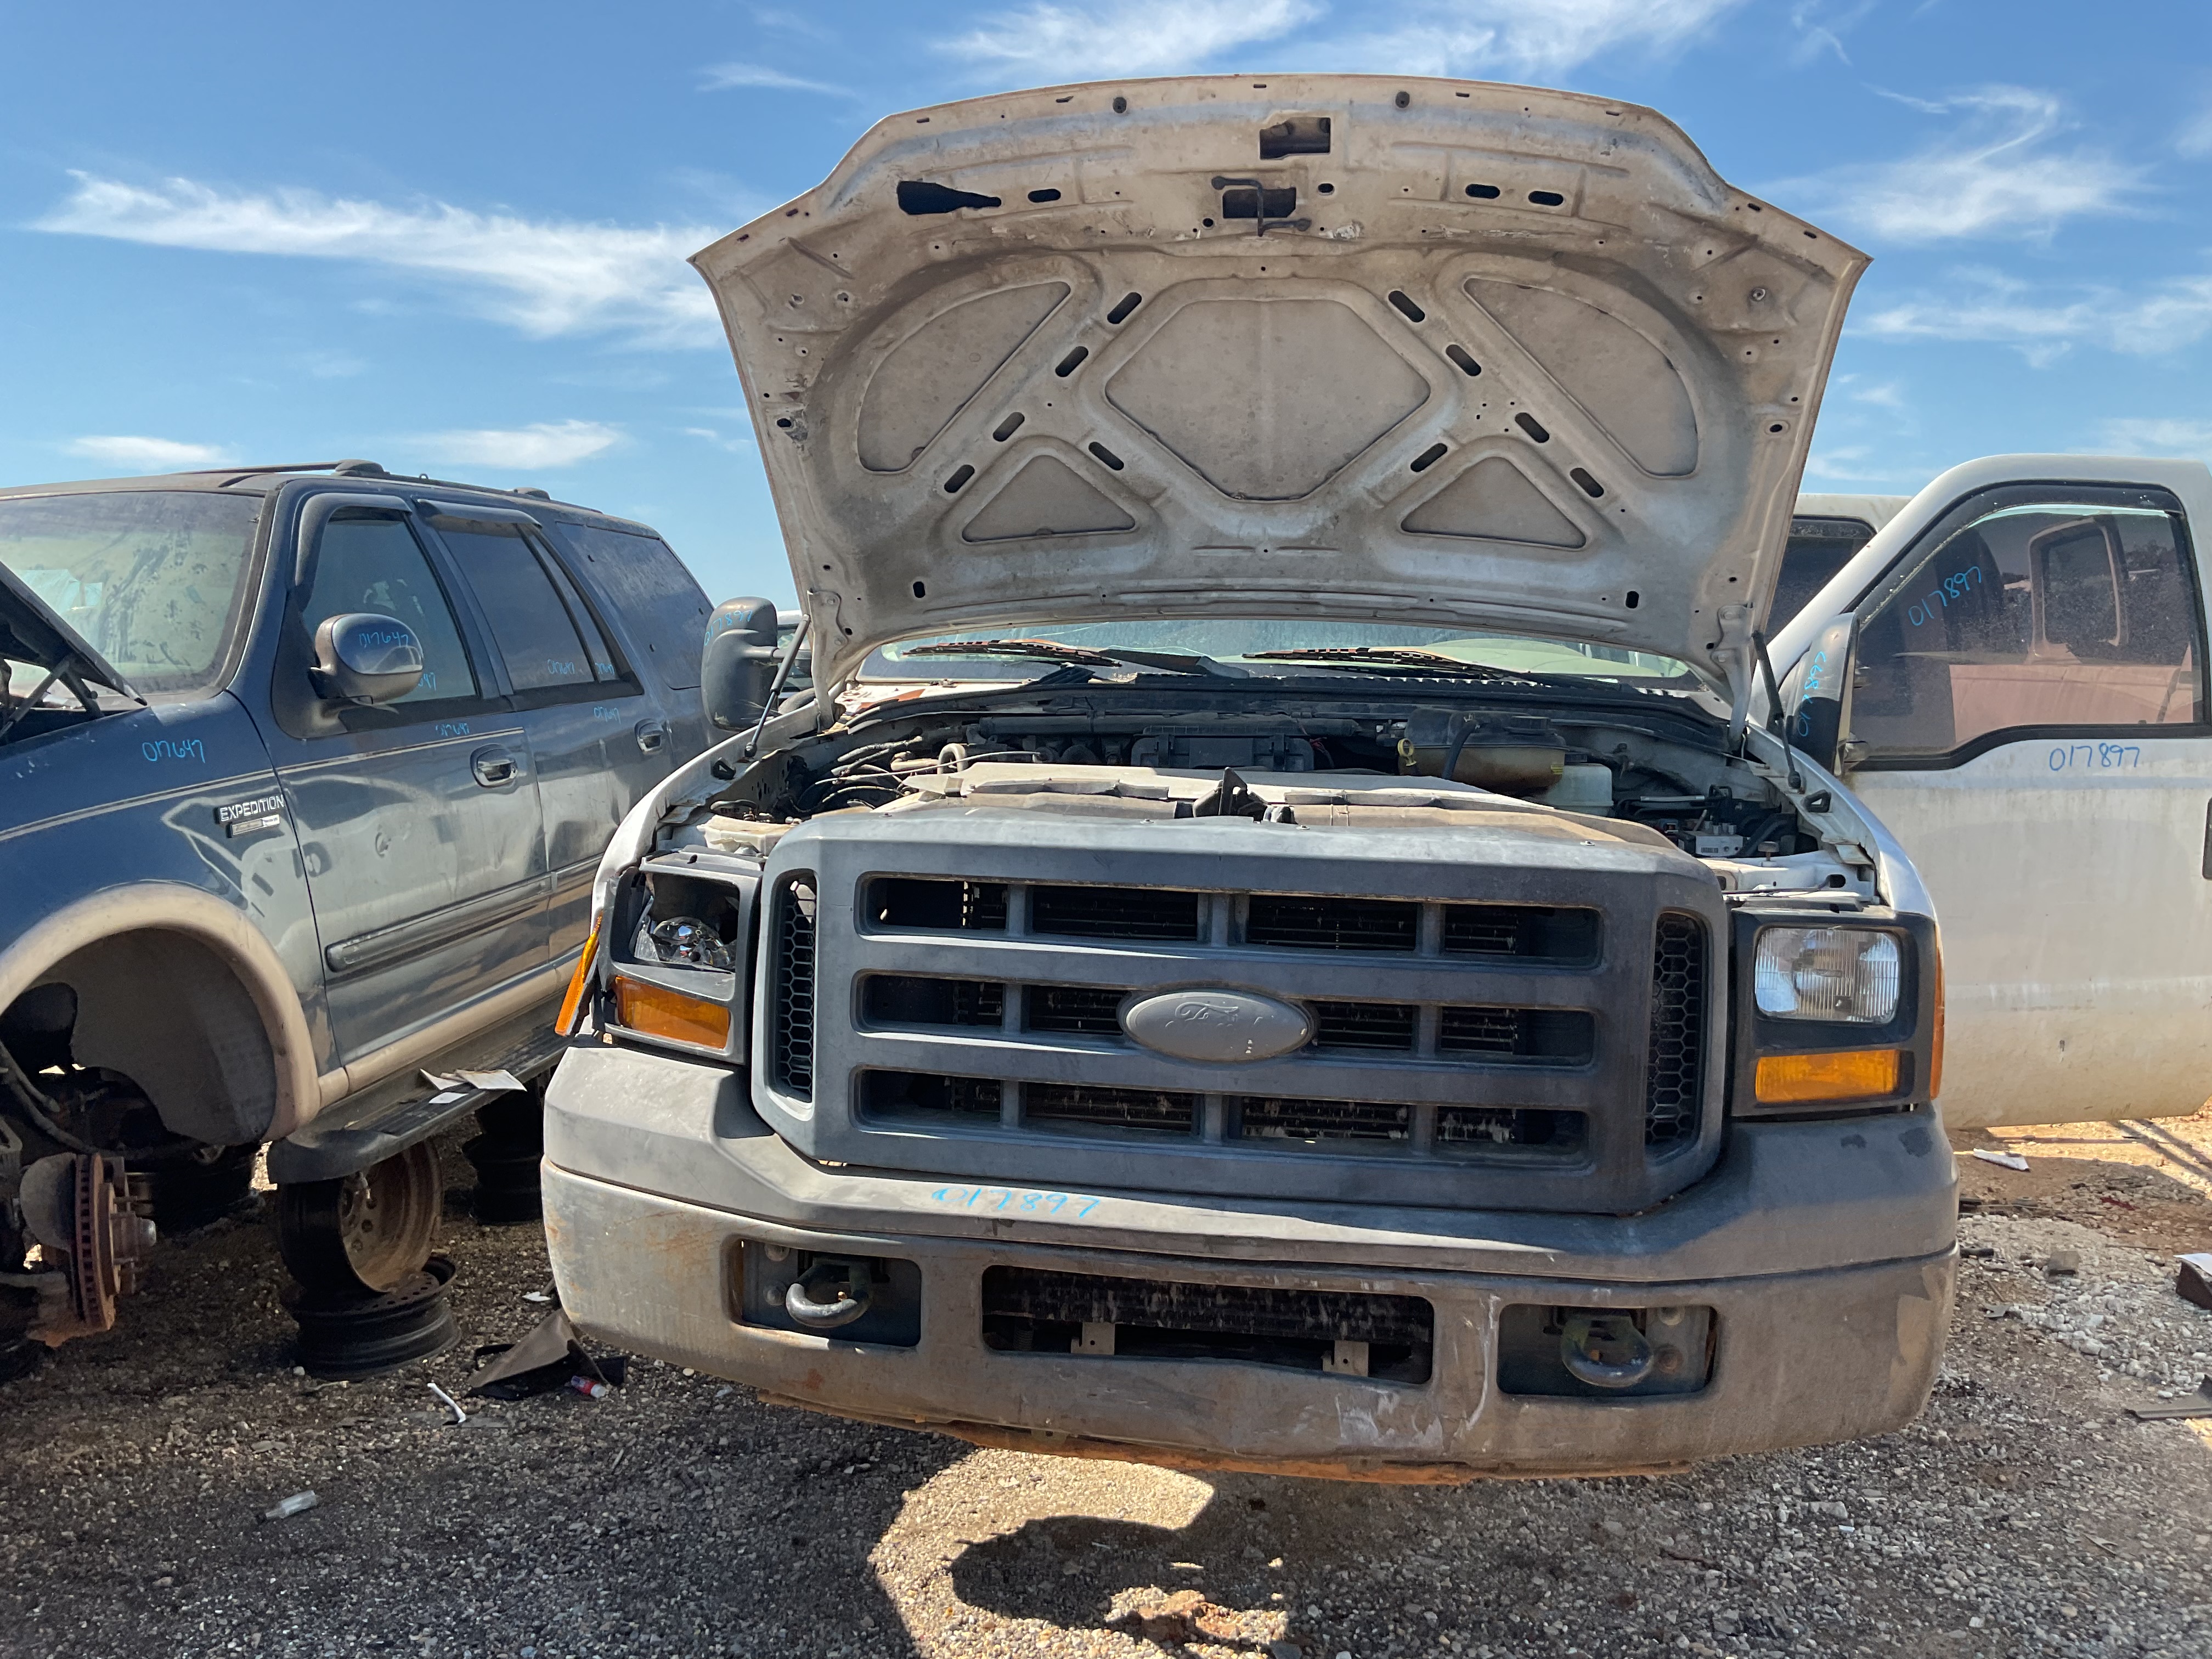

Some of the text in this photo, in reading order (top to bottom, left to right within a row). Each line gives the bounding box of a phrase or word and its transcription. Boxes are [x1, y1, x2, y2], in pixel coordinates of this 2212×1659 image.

[1908, 566, 1983, 627] 017897
[358, 631, 409, 648] 017647
[704, 610, 753, 646] 017897
[1797, 651, 1827, 737] 017897
[142, 739, 206, 764] 017647
[2048, 742, 2141, 772] 017897
[218, 794, 285, 822] EXPEDITION
[932, 1187, 1101, 1219] 017897
